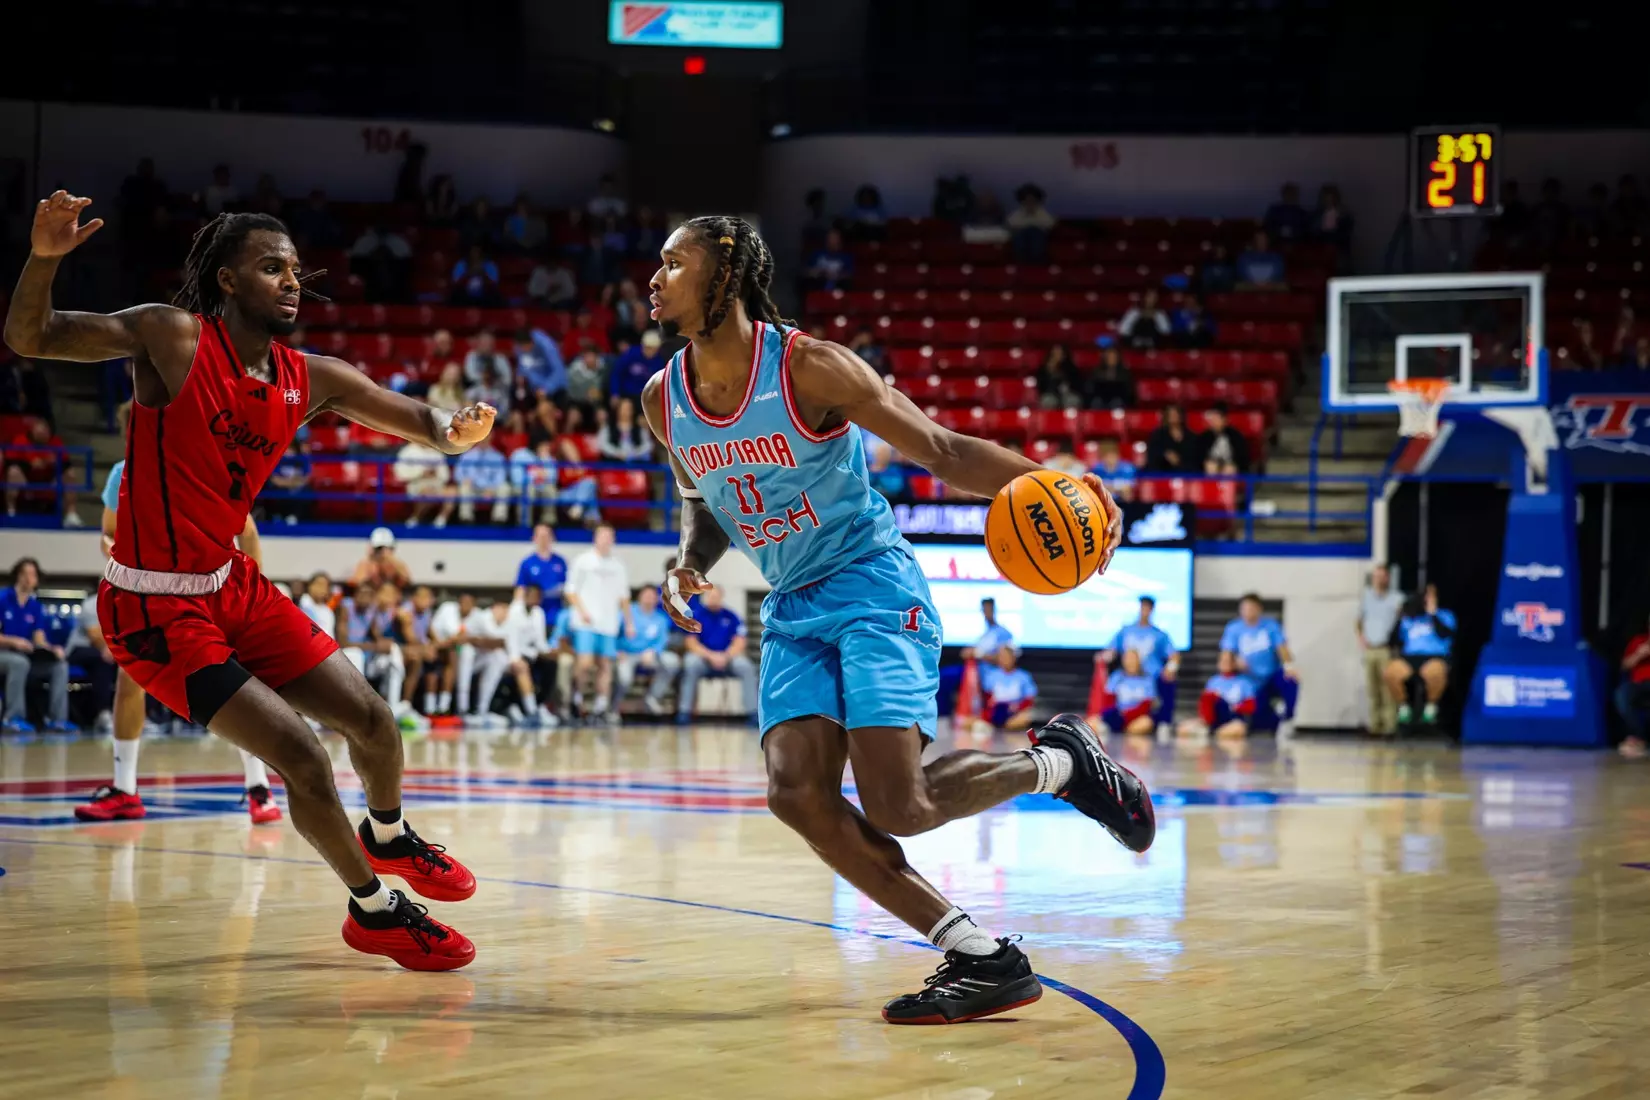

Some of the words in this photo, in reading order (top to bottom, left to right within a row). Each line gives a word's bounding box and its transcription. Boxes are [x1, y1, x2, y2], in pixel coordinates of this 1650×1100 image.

[362, 127, 411, 154] 104
[1437, 133, 1492, 163] 3:57
[1428, 161, 1486, 208] 21
[677, 431, 798, 480] LOUISIANA
[726, 472, 765, 515] 11
[1025, 501, 1066, 561] NCAA
[1053, 477, 1096, 558] Wilson
